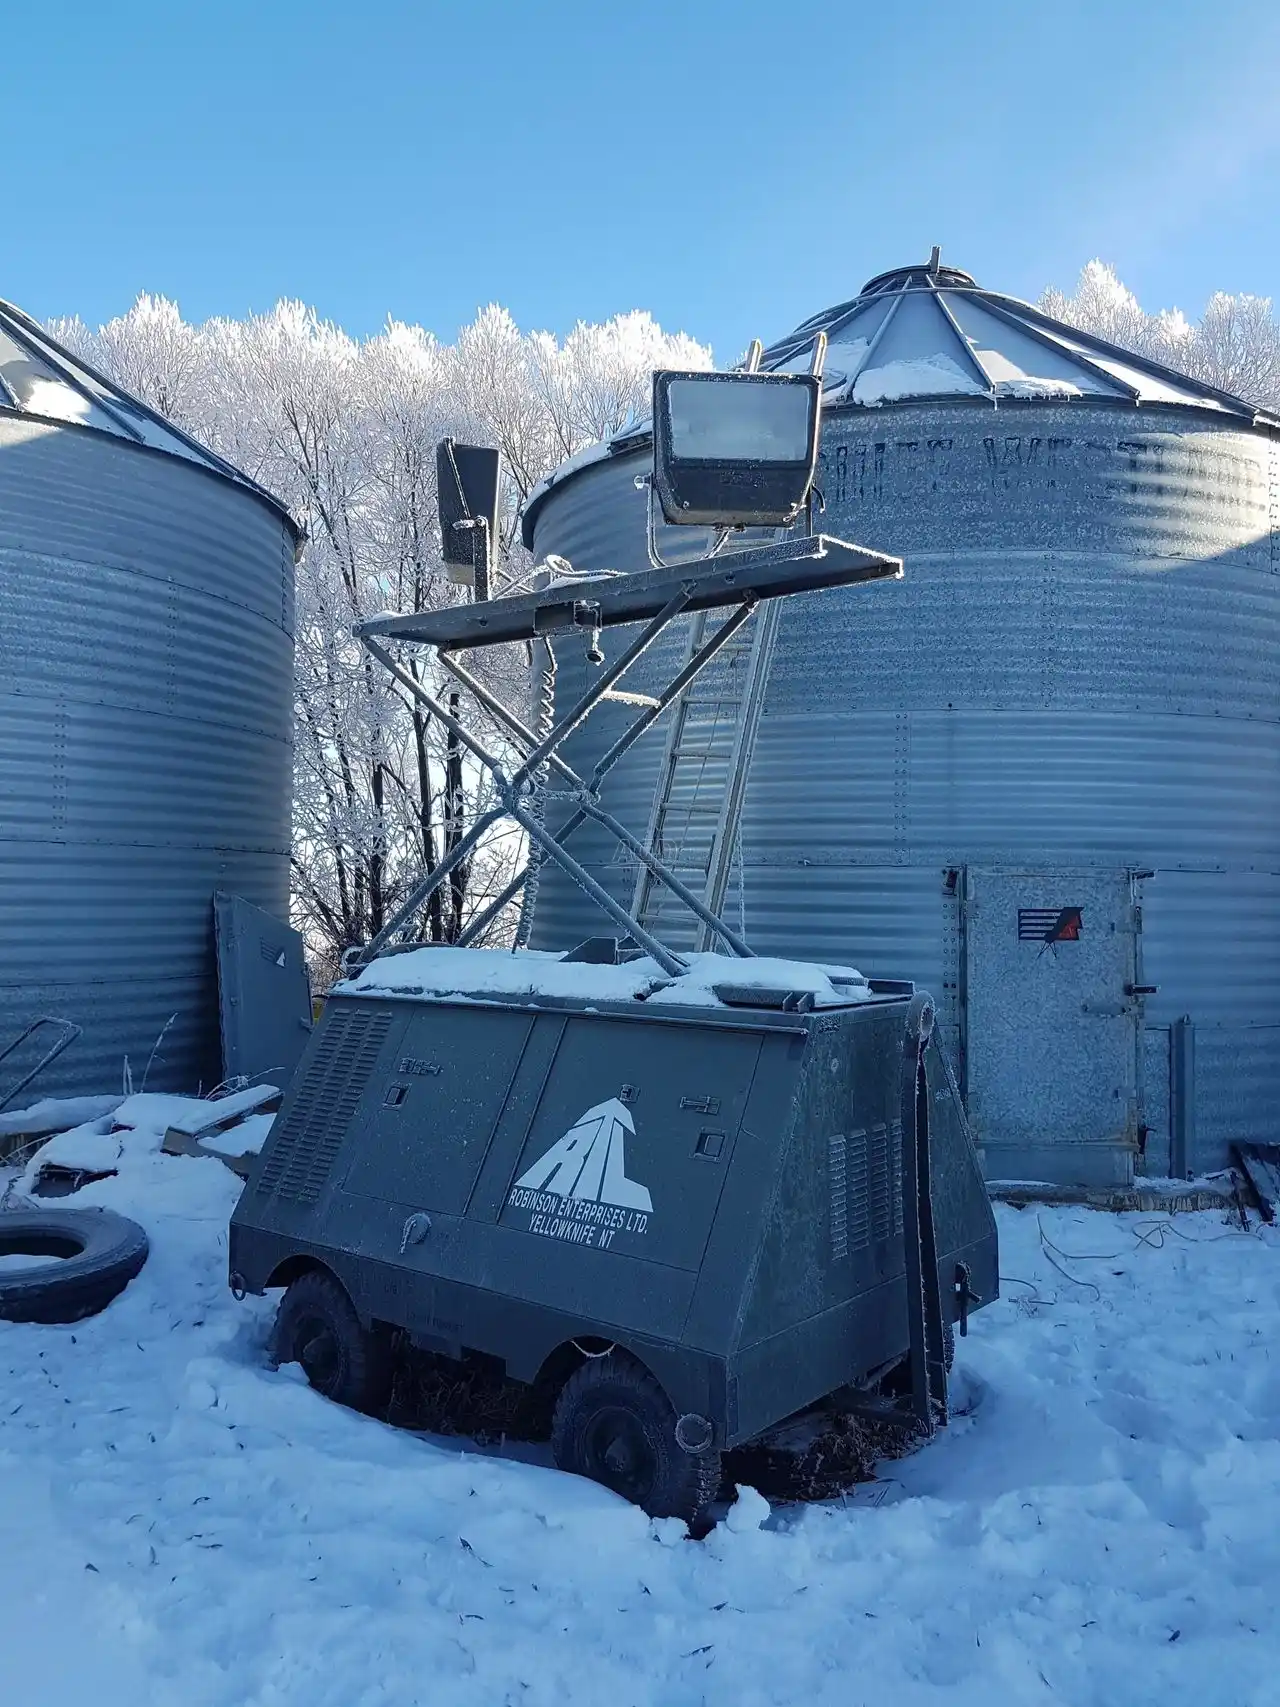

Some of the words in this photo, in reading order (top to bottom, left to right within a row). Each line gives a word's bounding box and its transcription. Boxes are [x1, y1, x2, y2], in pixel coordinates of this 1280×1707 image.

[508, 1189, 557, 1213] ROBINSON
[560, 1197, 626, 1229] ENTERPRISES
[626, 1212, 648, 1234] LTD.
[529, 1213, 596, 1245] YELLOWKNIFE
[598, 1229, 616, 1249] NT
